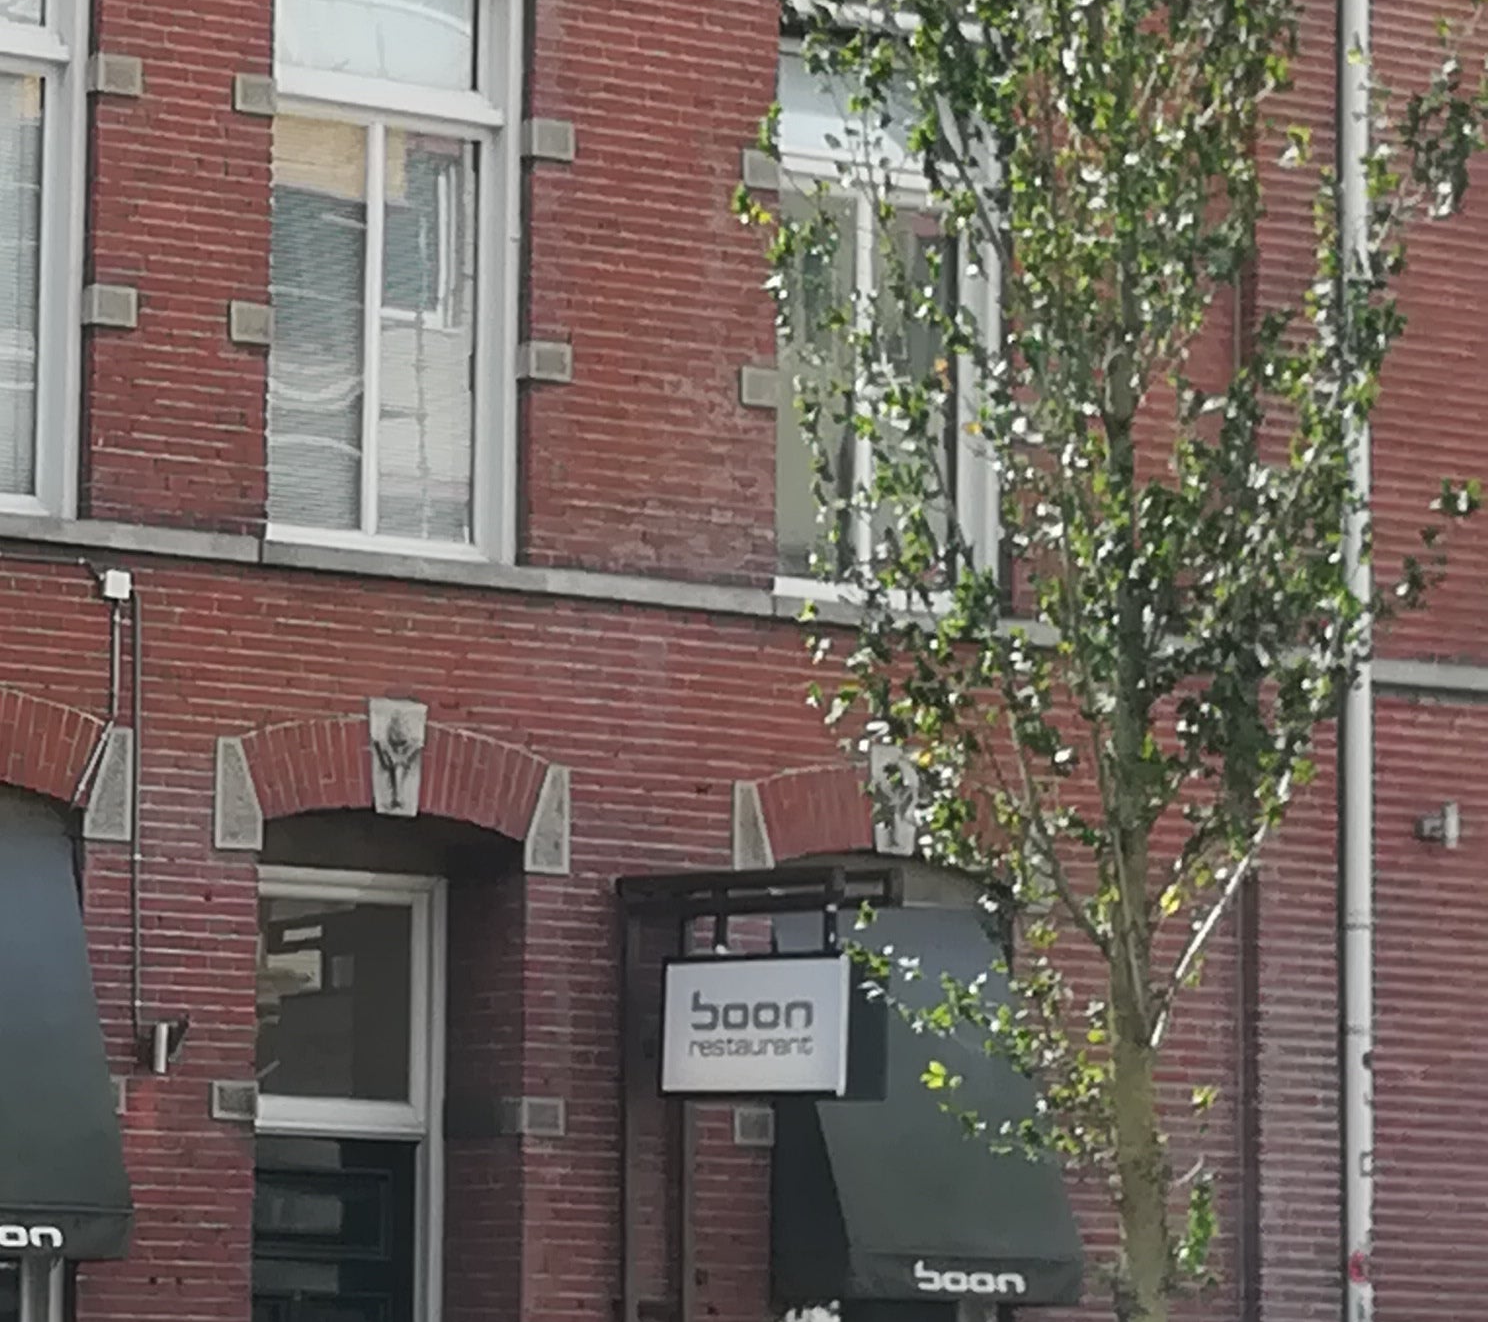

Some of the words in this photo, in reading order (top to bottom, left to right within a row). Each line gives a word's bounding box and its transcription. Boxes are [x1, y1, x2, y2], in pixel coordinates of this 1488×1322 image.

[690, 990, 814, 1030] boon
[688, 1034, 814, 1058] restaurant
[914, 1259, 1027, 1294] boon
